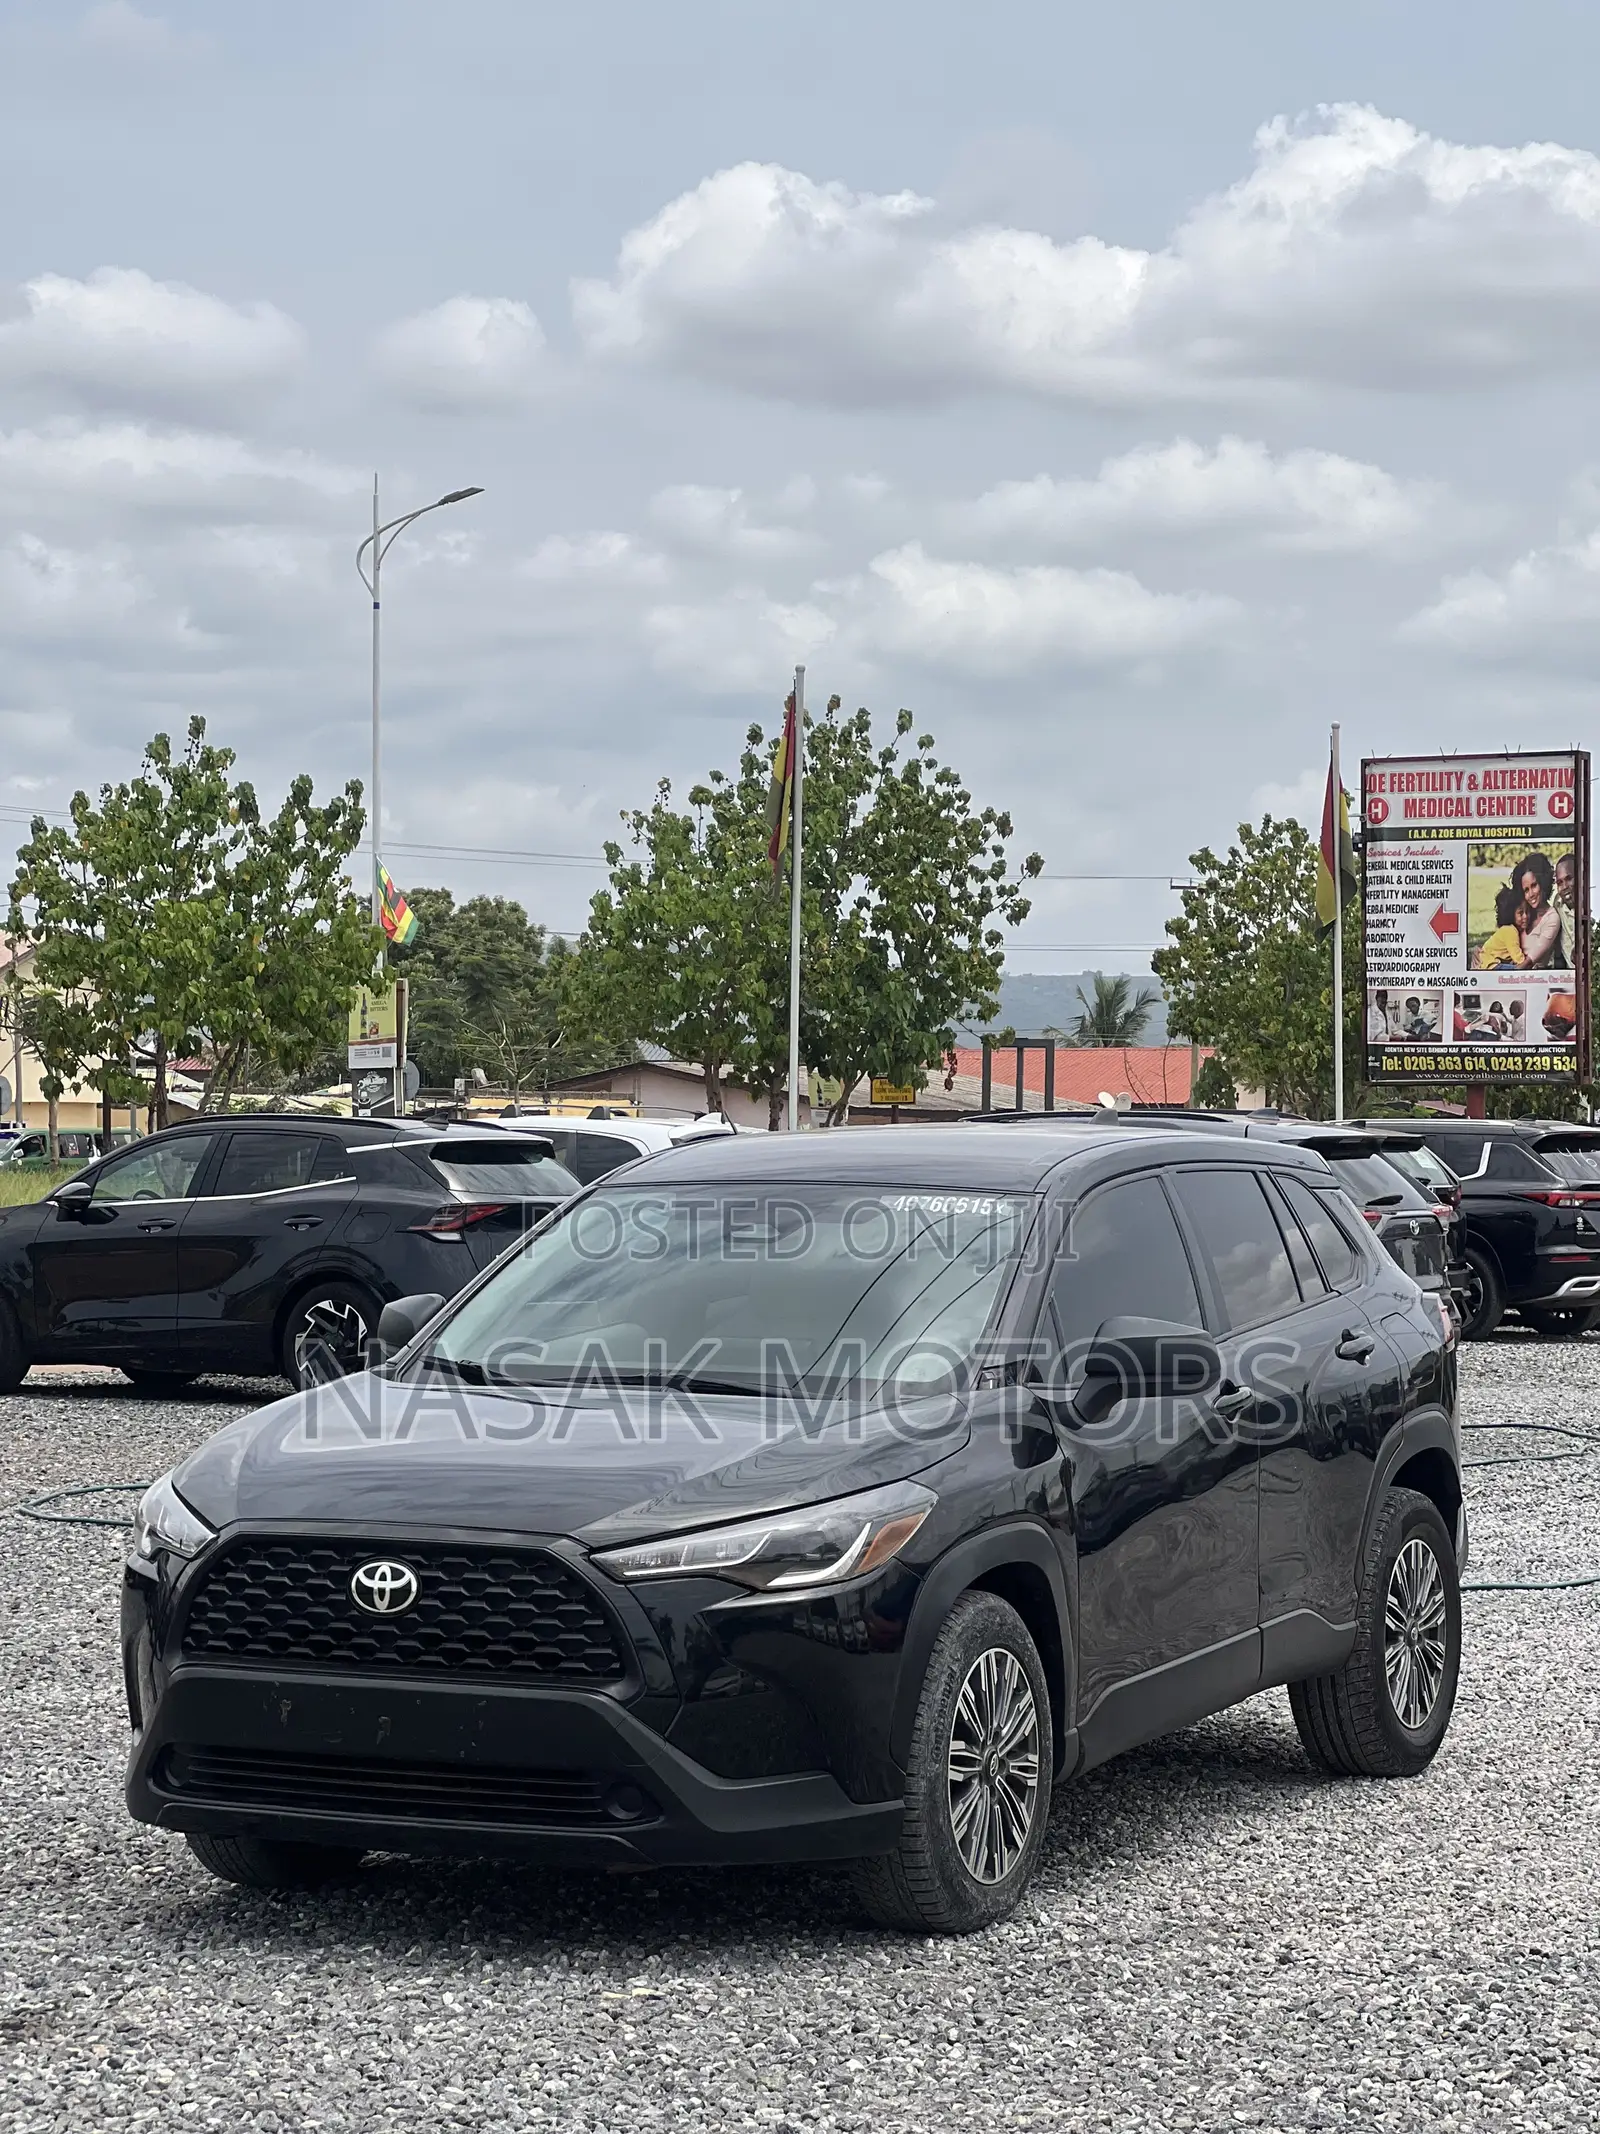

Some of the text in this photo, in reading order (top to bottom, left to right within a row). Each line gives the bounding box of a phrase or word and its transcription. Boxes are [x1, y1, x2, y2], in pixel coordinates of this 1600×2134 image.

[1390, 771, 1464, 793] FERTILITY
[1467, 773, 1479, 791] &
[1404, 795, 1536, 818] MEDICAL CENTRE
[1439, 829, 1454, 838] ZOE
[1455, 828, 1483, 838] ROYAL
[1484, 827, 1526, 838] HOSPITAL
[1367, 845, 1444, 857] Services Include:
[1366, 859, 1454, 871] ENERAL MEDICAL SERVICES
[1396, 875, 1403, 885] &
[1404, 875, 1425, 885] CHILD
[1426, 874, 1452, 885] HEALTH
[1401, 889, 1449, 899] MANAGEMENT
[1385, 904, 1419, 914] MEDICINE
[1405, 947, 1424, 957] SCAN
[1425, 947, 1458, 957] SERVICES
[1426, 976, 1469, 986] MASSAGING
[1382, 1055, 1402, 1070] Tel:
[1403, 1056, 1436, 1071] 0205
[1437, 1056, 1462, 1071] 363
[1490, 1056, 1523, 1071] 0243
[1525, 1056, 1551, 1071] 239
[1553, 1055, 1577, 1071] 534
[1415, 1072, 1547, 1080] www.zoeroyalhospital.com
